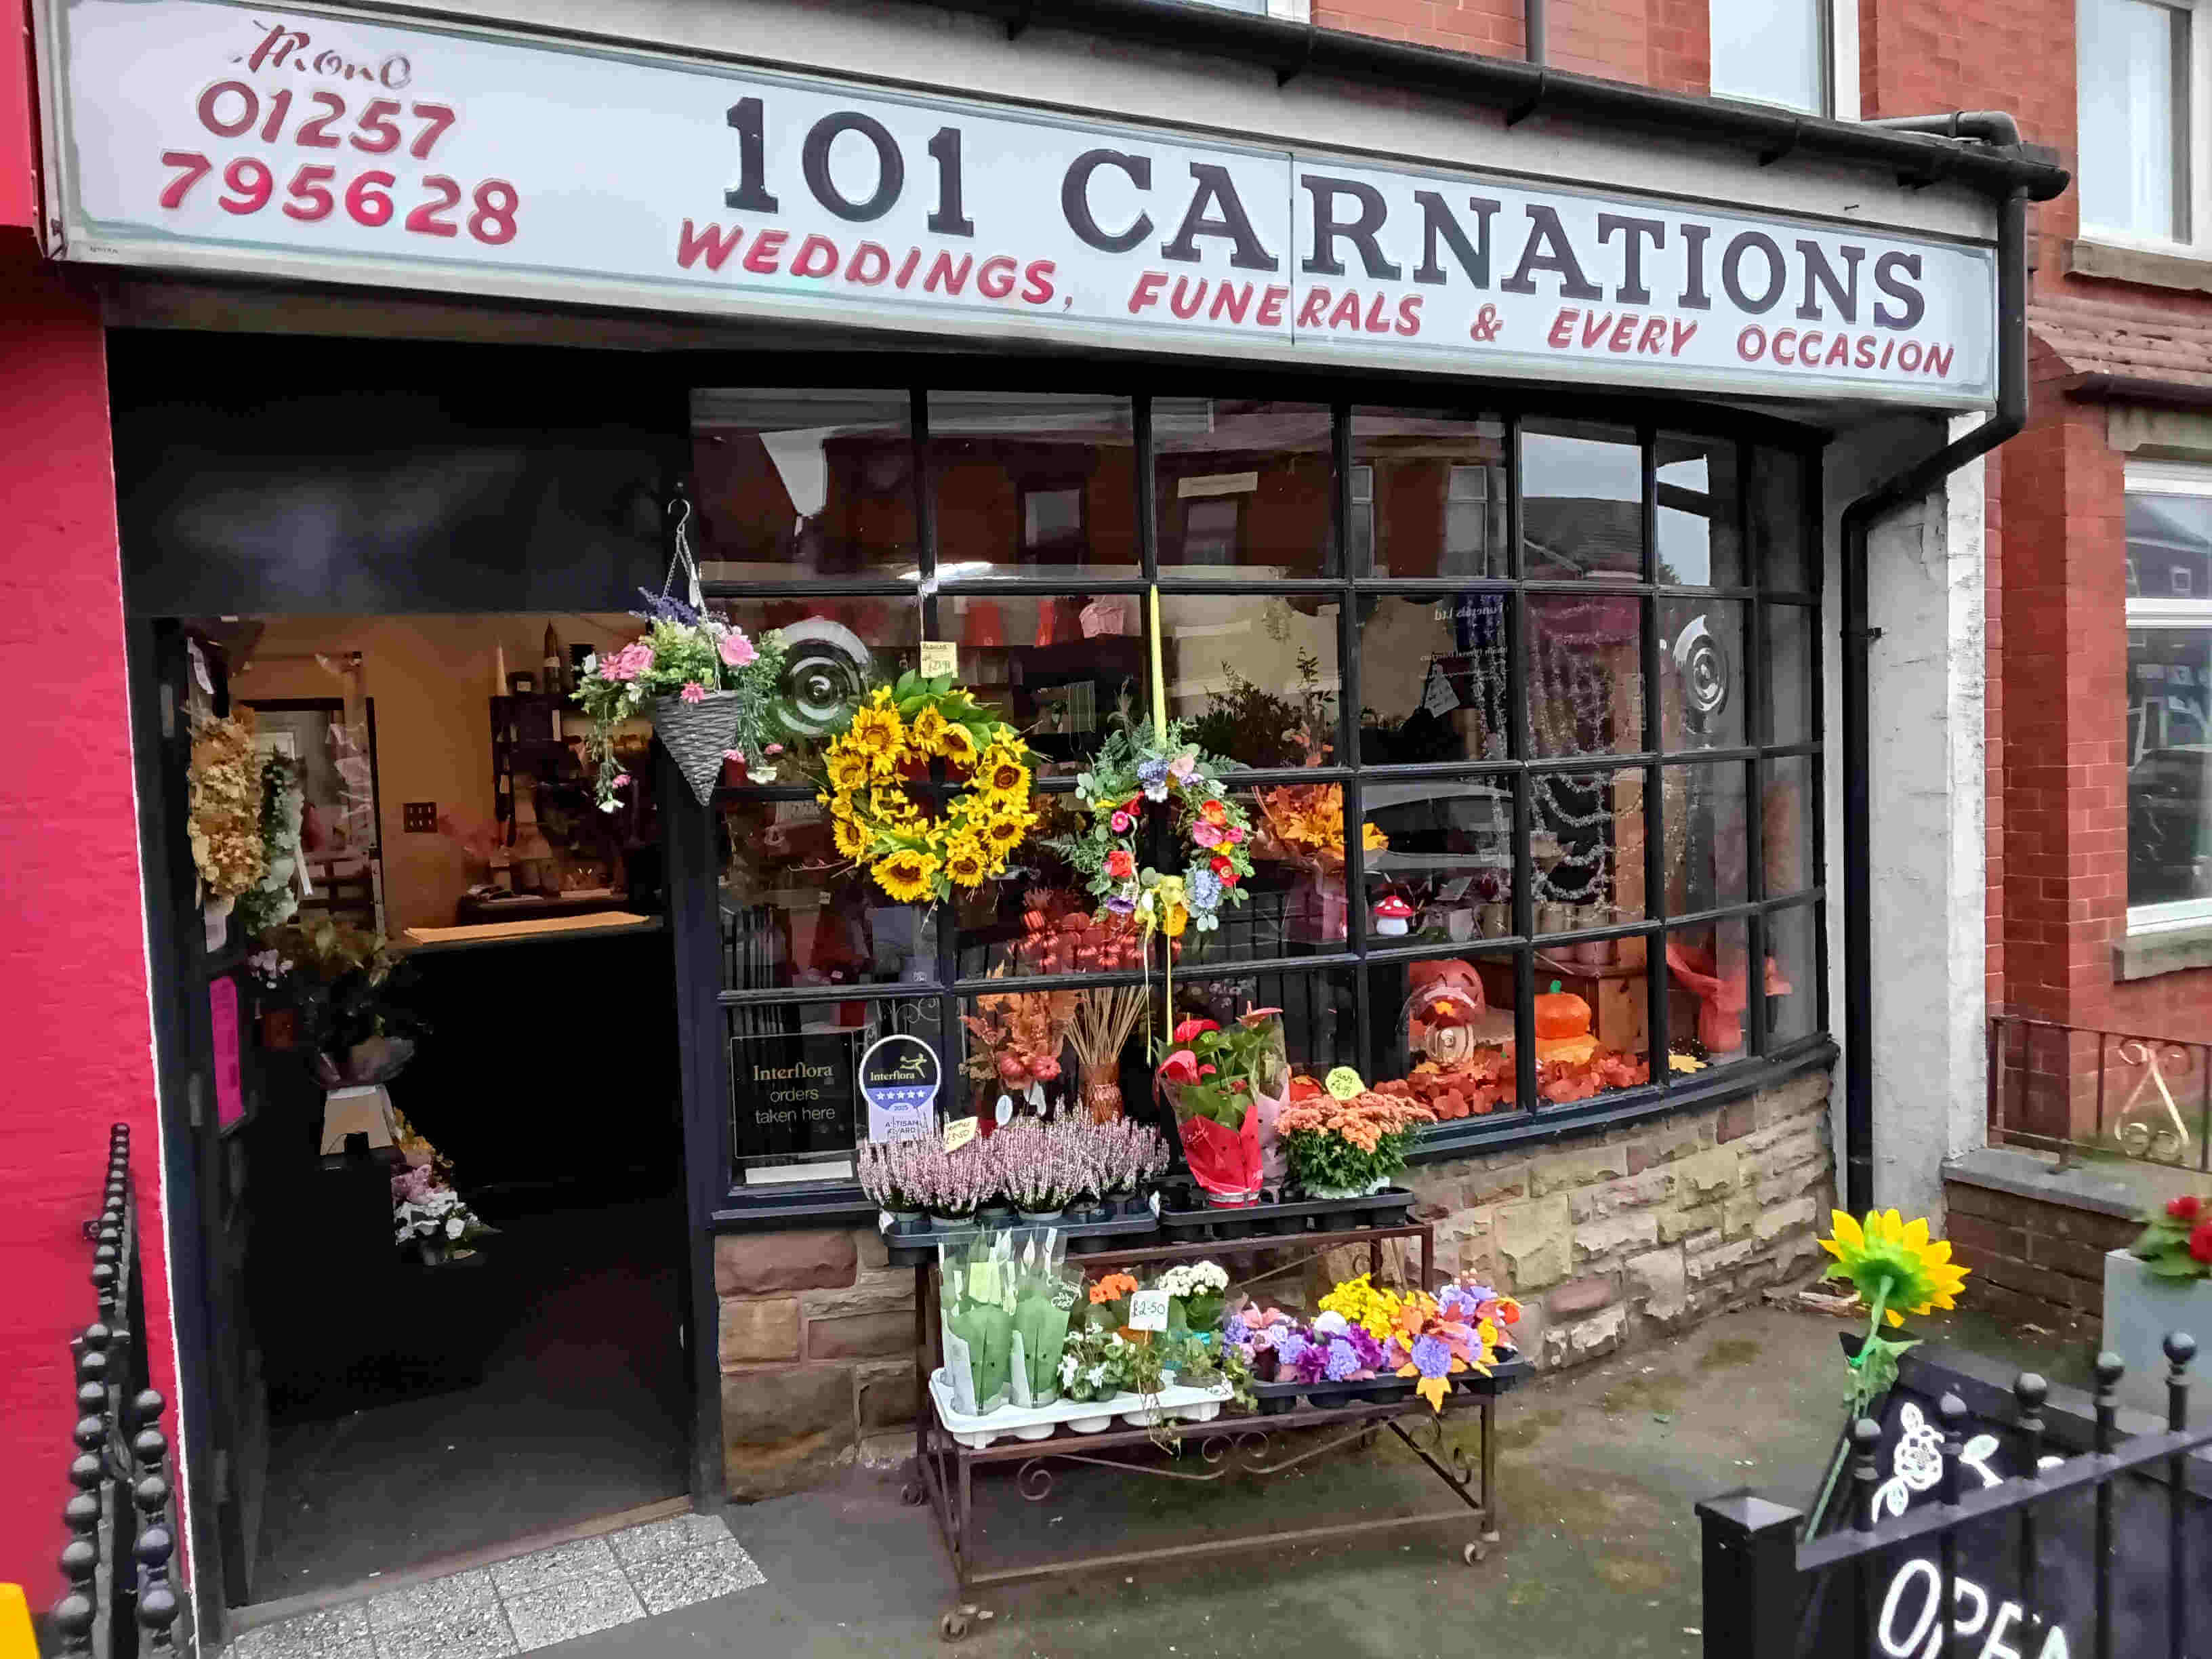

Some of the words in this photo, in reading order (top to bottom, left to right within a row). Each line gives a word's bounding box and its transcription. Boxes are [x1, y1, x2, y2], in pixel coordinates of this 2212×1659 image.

[197, 79, 457, 161] 01257
[159, 148, 521, 247] 795628
[724, 96, 975, 238] 101
[1061, 147, 1925, 331] CARNATIONS
[676, 217, 1074, 312] WEDDINGS,
[1127, 270, 1424, 337] FUNERALS
[1469, 302, 1506, 343] &
[1547, 306, 1698, 358] EVERY
[1736, 323, 1955, 378] OCCASION
[753, 1061, 834, 1082] Interflora
[770, 1086, 819, 1103] orders
[869, 1069, 916, 1082] Interflora
[754, 1108, 798, 1124] taken
[802, 1106, 836, 1122] here
[1878, 1559, 2071, 1659] OPE
